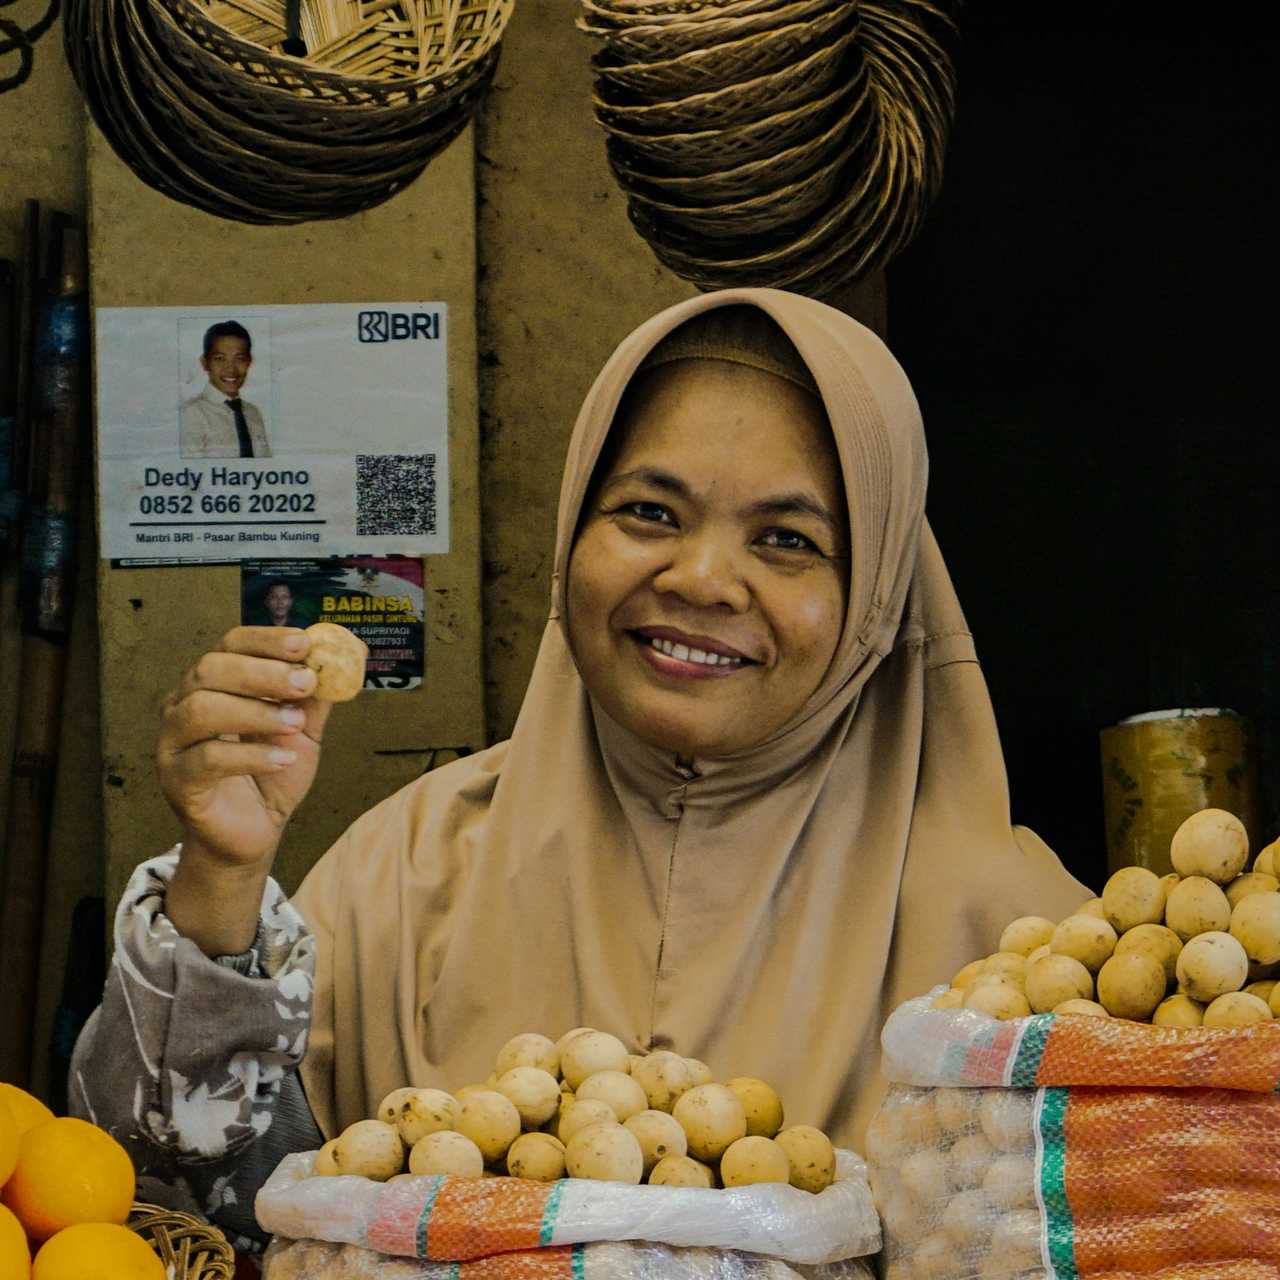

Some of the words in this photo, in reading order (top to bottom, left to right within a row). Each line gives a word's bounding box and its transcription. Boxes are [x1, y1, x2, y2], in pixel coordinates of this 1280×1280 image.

[391, 312, 439, 340] BRI
[144, 467, 203, 491] Dedy
[211, 467, 310, 490] Haryono
[139, 495, 194, 515] 0852
[201, 494, 241, 514] 666
[248, 493, 316, 513] 20202
[136, 532, 170, 543] Mantri
[173, 532, 194, 543] BRI
[203, 532, 235, 543] Pasar
[238, 531, 277, 542] Bambu
[280, 531, 321, 544] Kuning
[322, 596, 414, 612] BABINSA
